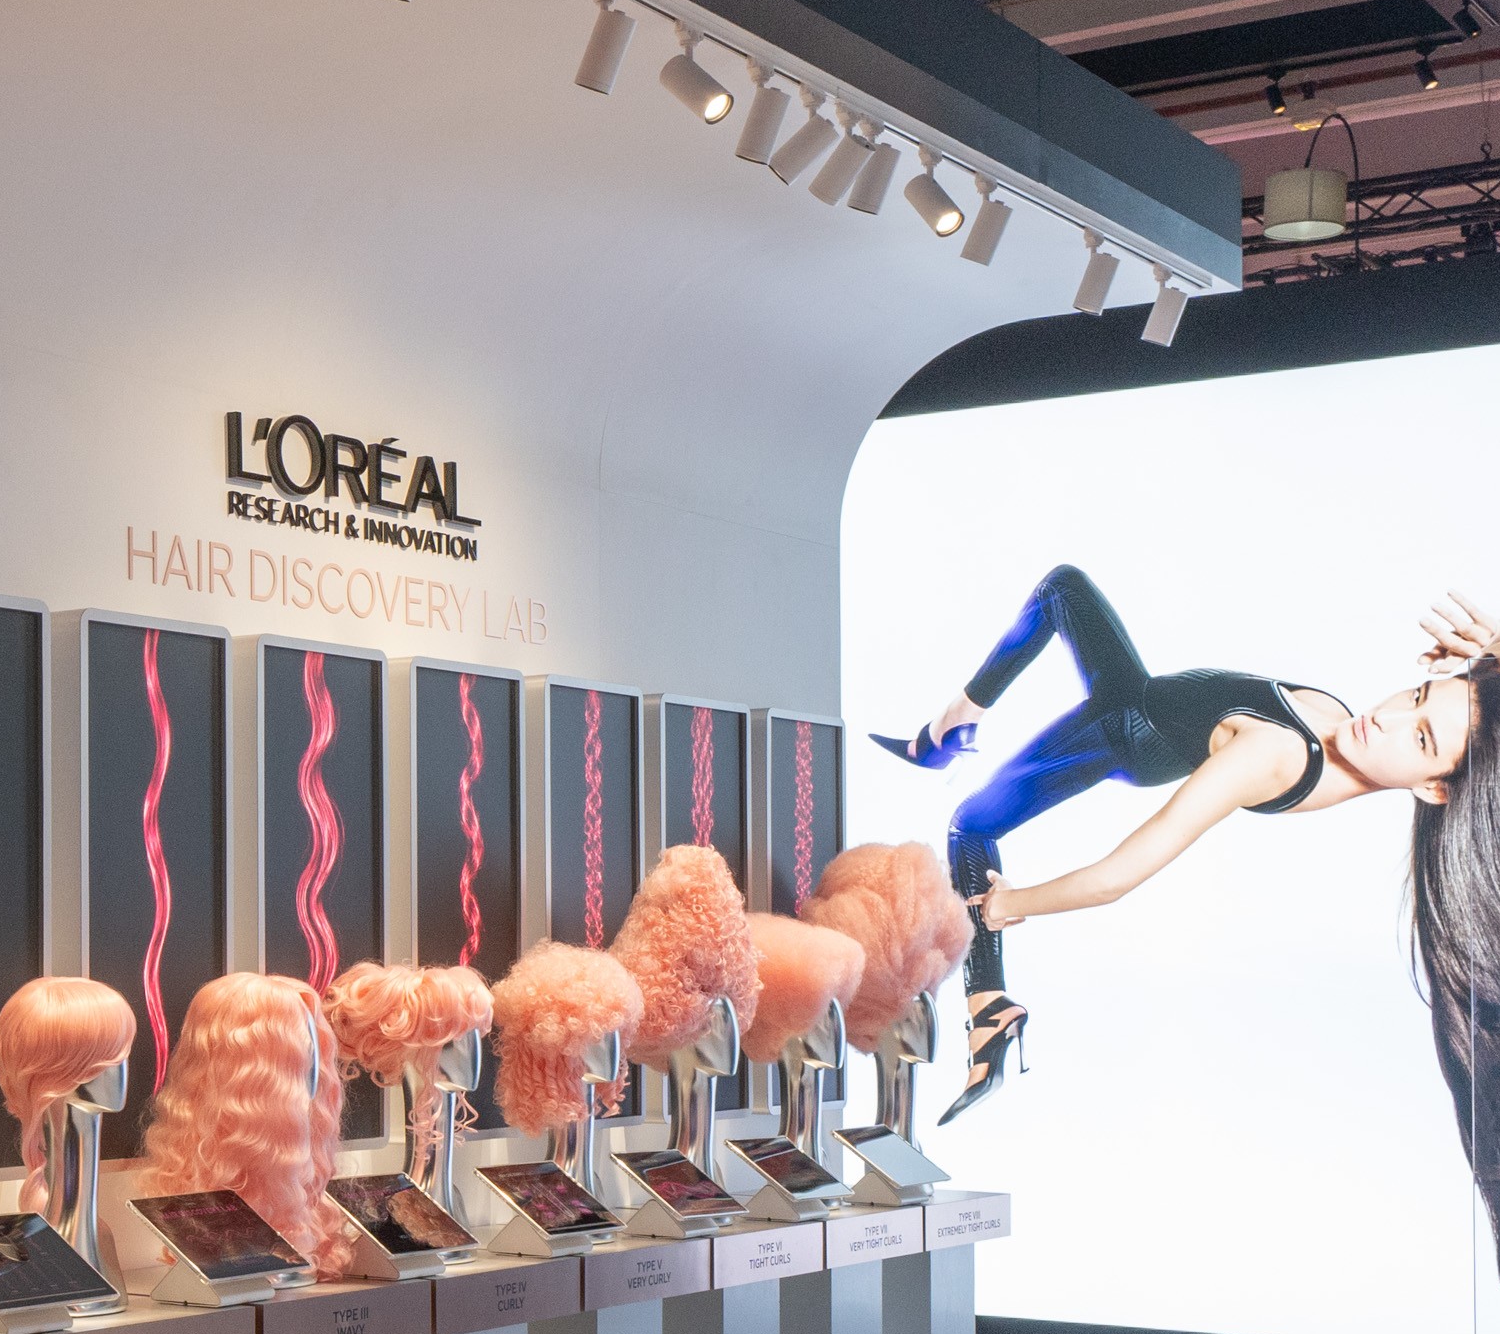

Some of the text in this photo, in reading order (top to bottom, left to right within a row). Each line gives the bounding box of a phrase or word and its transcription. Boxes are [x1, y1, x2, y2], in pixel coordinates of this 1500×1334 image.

[223, 411, 482, 527] L'ORÉAL
[226, 490, 479, 562] RESEARCH & INNOVATION
[126, 525, 549, 646] HAIR DISCOVERY LAB
[958, 1211, 972, 1222] TYPE
[864, 1225, 879, 1237] TYPE
[937, 1218, 1001, 1238] EXTREMELY TIGHT CURLS
[758, 1241, 783, 1254] TYPE VI
[849, 1234, 903, 1252] VERY TIGHT CURLS
[636, 1259, 663, 1273] TYPE V
[749, 1253, 791, 1269] TIGHT CURLS
[494, 1280, 527, 1297] TYPE IV
[627, 1271, 672, 1290] VERY CURLY
[497, 1296, 525, 1312] CURLY
[332, 1306, 369, 1324] TYPE III
